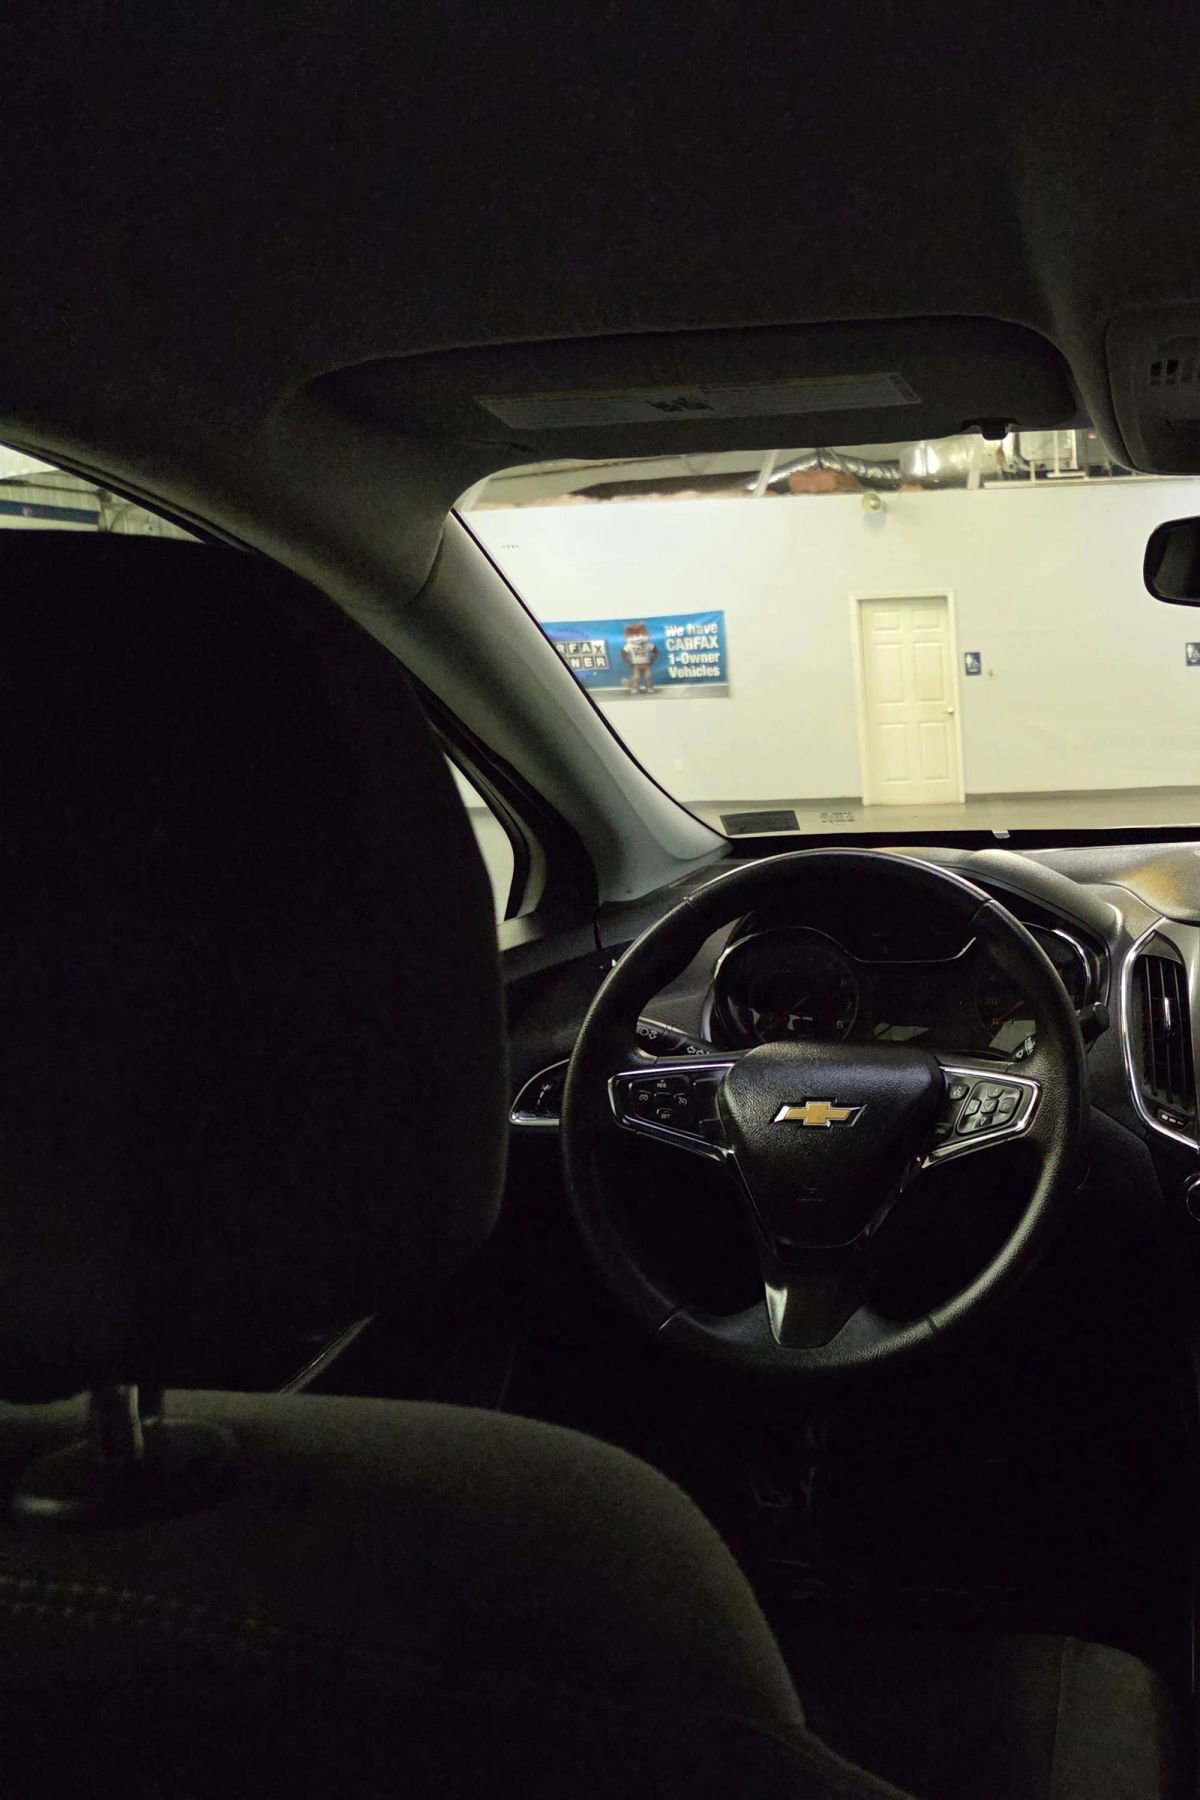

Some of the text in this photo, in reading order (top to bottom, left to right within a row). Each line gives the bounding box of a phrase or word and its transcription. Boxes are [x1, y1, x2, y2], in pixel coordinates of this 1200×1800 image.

[664, 623, 718, 637] We have
[556, 641, 606, 654] RFAX
[666, 635, 719, 651] CARFAX
[570, 656, 606, 669] NER
[668, 652, 721, 665] 1-Owner
[668, 664, 721, 679] Vehicles
